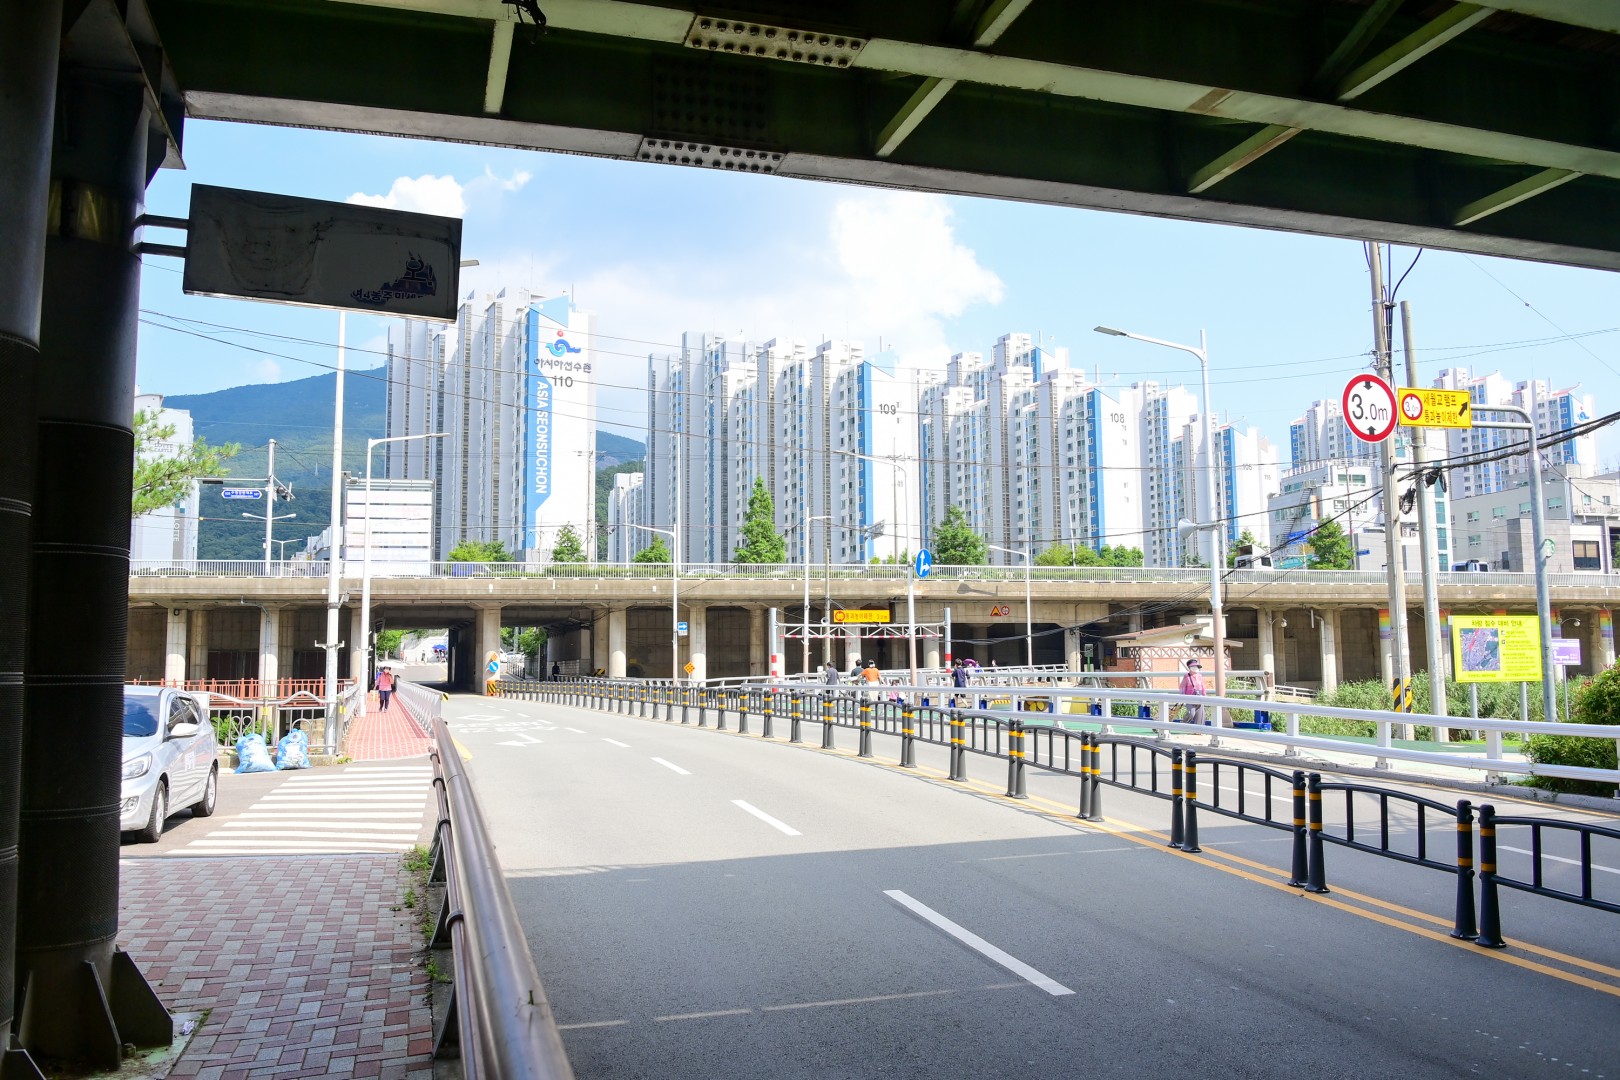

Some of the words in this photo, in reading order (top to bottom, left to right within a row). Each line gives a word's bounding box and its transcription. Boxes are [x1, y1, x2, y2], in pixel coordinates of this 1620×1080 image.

[533, 358, 592, 374] 아시아선수촌
[552, 375, 574, 388] 110
[536, 381, 549, 409] ASIA
[879, 403, 897, 415] 109
[1351, 393, 1389, 421] 3.0m
[1110, 412, 1125, 424] 108
[535, 411, 549, 494] SEONSUCHON
